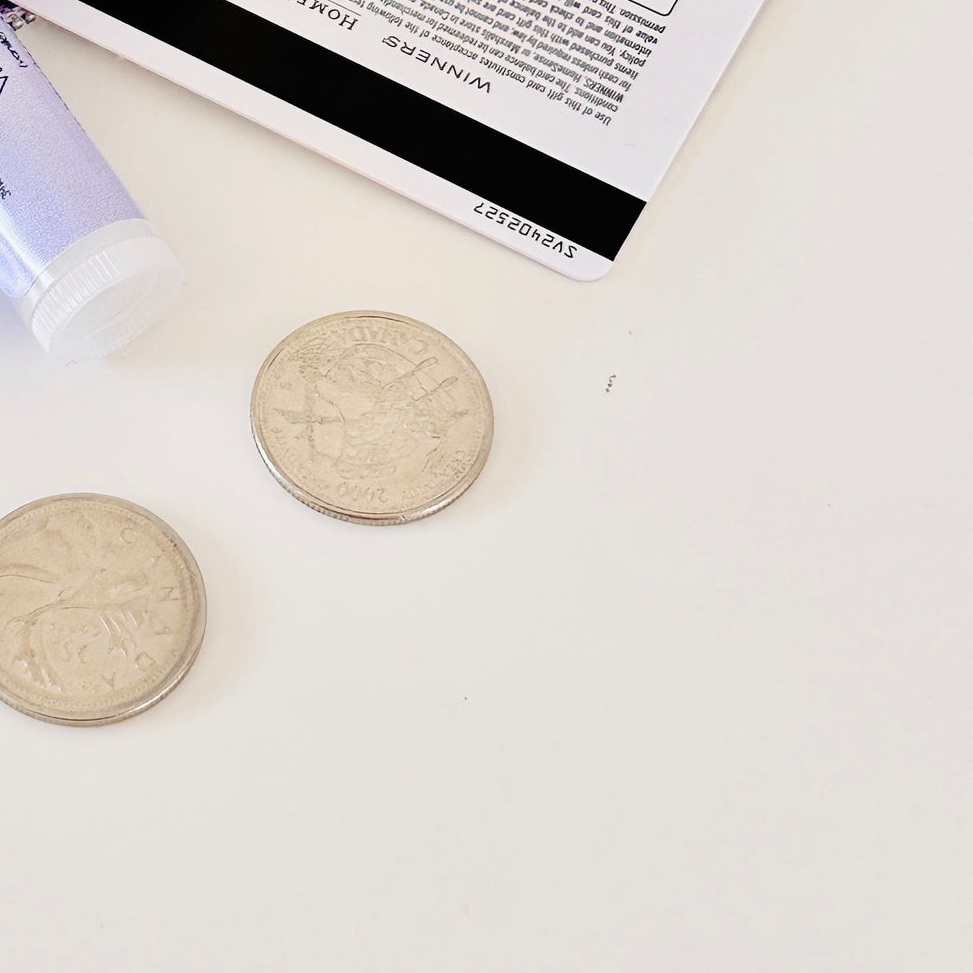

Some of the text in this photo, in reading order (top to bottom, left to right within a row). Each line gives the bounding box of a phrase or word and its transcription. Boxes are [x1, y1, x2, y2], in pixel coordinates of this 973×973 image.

[453, 2, 466, 14] be
[482, 1, 497, 12] are
[508, 0, 541, 20] balance
[549, 4, 574, 20] check
[581, 5, 602, 19] card
[598, 0, 616, 14] This
[366, 1, 403, 27] following
[449, 14, 460, 24] in
[464, 7, 494, 25] cannot
[495, 7, 516, 21] card
[541, 15, 556, 27] the
[404, 21, 419, 34] the
[425, 17, 438, 29] for
[459, 18, 481, 33] store
[491, 20, 510, 32] and
[515, 17, 533, 29] gift
[557, 22, 567, 32] to
[574, 16, 585, 27] to
[584, 21, 603, 33] and
[604, 15, 621, 29] this
[418, 29, 430, 38] of
[436, 22, 478, 46] redeemed
[532, 24, 550, 38] this
[565, 26, 584, 39] add
[621, 24, 634, 34] of
[481, 29, 521, 54] Marshalls
[526, 34, 538, 48] by
[549, 33, 569, 46] with
[584, 34, 601, 46] can
[603, 29, 652, 57] information
[635, 30, 658, 44] value
[431, 34, 478, 60] acceptance
[477, 41, 489, 53] be
[488, 47, 505, 59] can
[520, 48, 531, 57] or
[535, 41, 571, 61] required
[568, 42, 614, 66] purchased
[600, 42, 616, 56] You
[384, 35, 490, 93] WINNERS
[479, 56, 526, 83] constitutes
[504, 54, 537, 76] balance
[570, 57, 599, 74] unless
[613, 62, 639, 80] Items
[534, 69, 556, 83] card
[598, 69, 619, 84] cash
[525, 79, 546, 93] card
[555, 78, 571, 93] The
[618, 80, 632, 92] for
[546, 89, 564, 101] gift
[564, 97, 582, 111] this
[581, 106, 593, 115] of
[594, 111, 612, 126] Use
[473, 202, 577, 258] SV2402527
